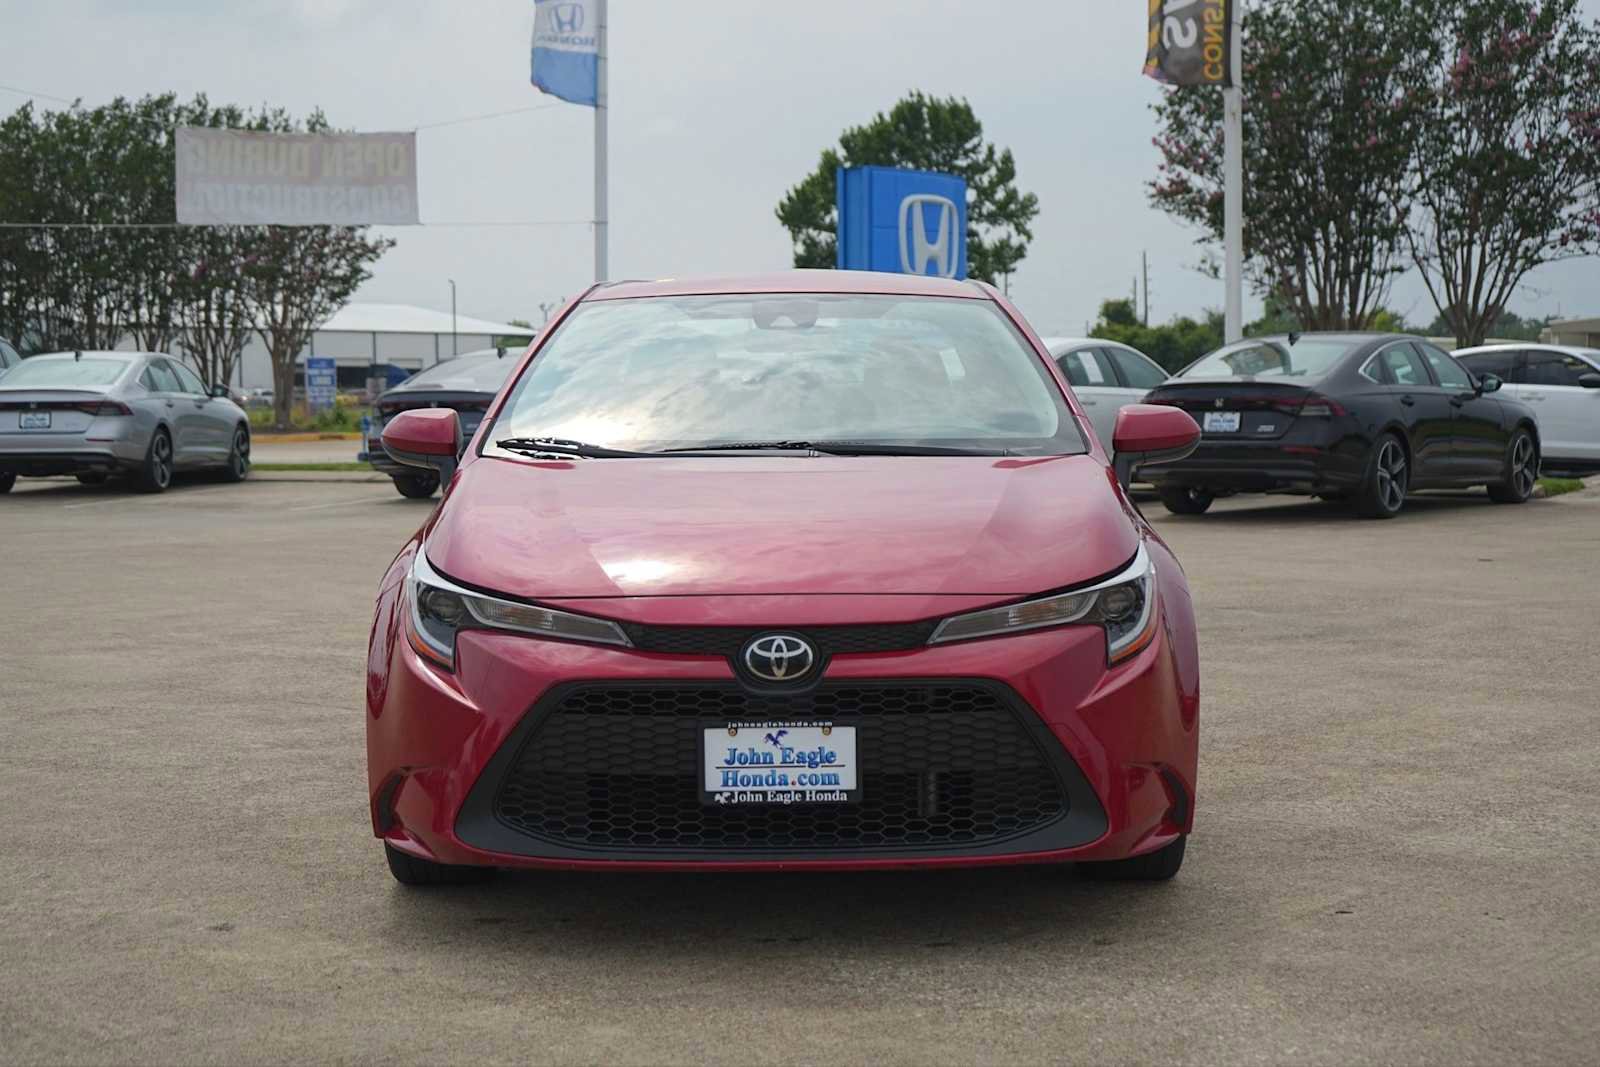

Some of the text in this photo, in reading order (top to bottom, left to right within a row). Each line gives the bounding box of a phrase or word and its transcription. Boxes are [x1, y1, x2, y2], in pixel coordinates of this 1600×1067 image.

[724, 746, 837, 769] John Eagle
[720, 770, 841, 787] Honda.com
[731, 790, 848, 805] John Eagle Honda
